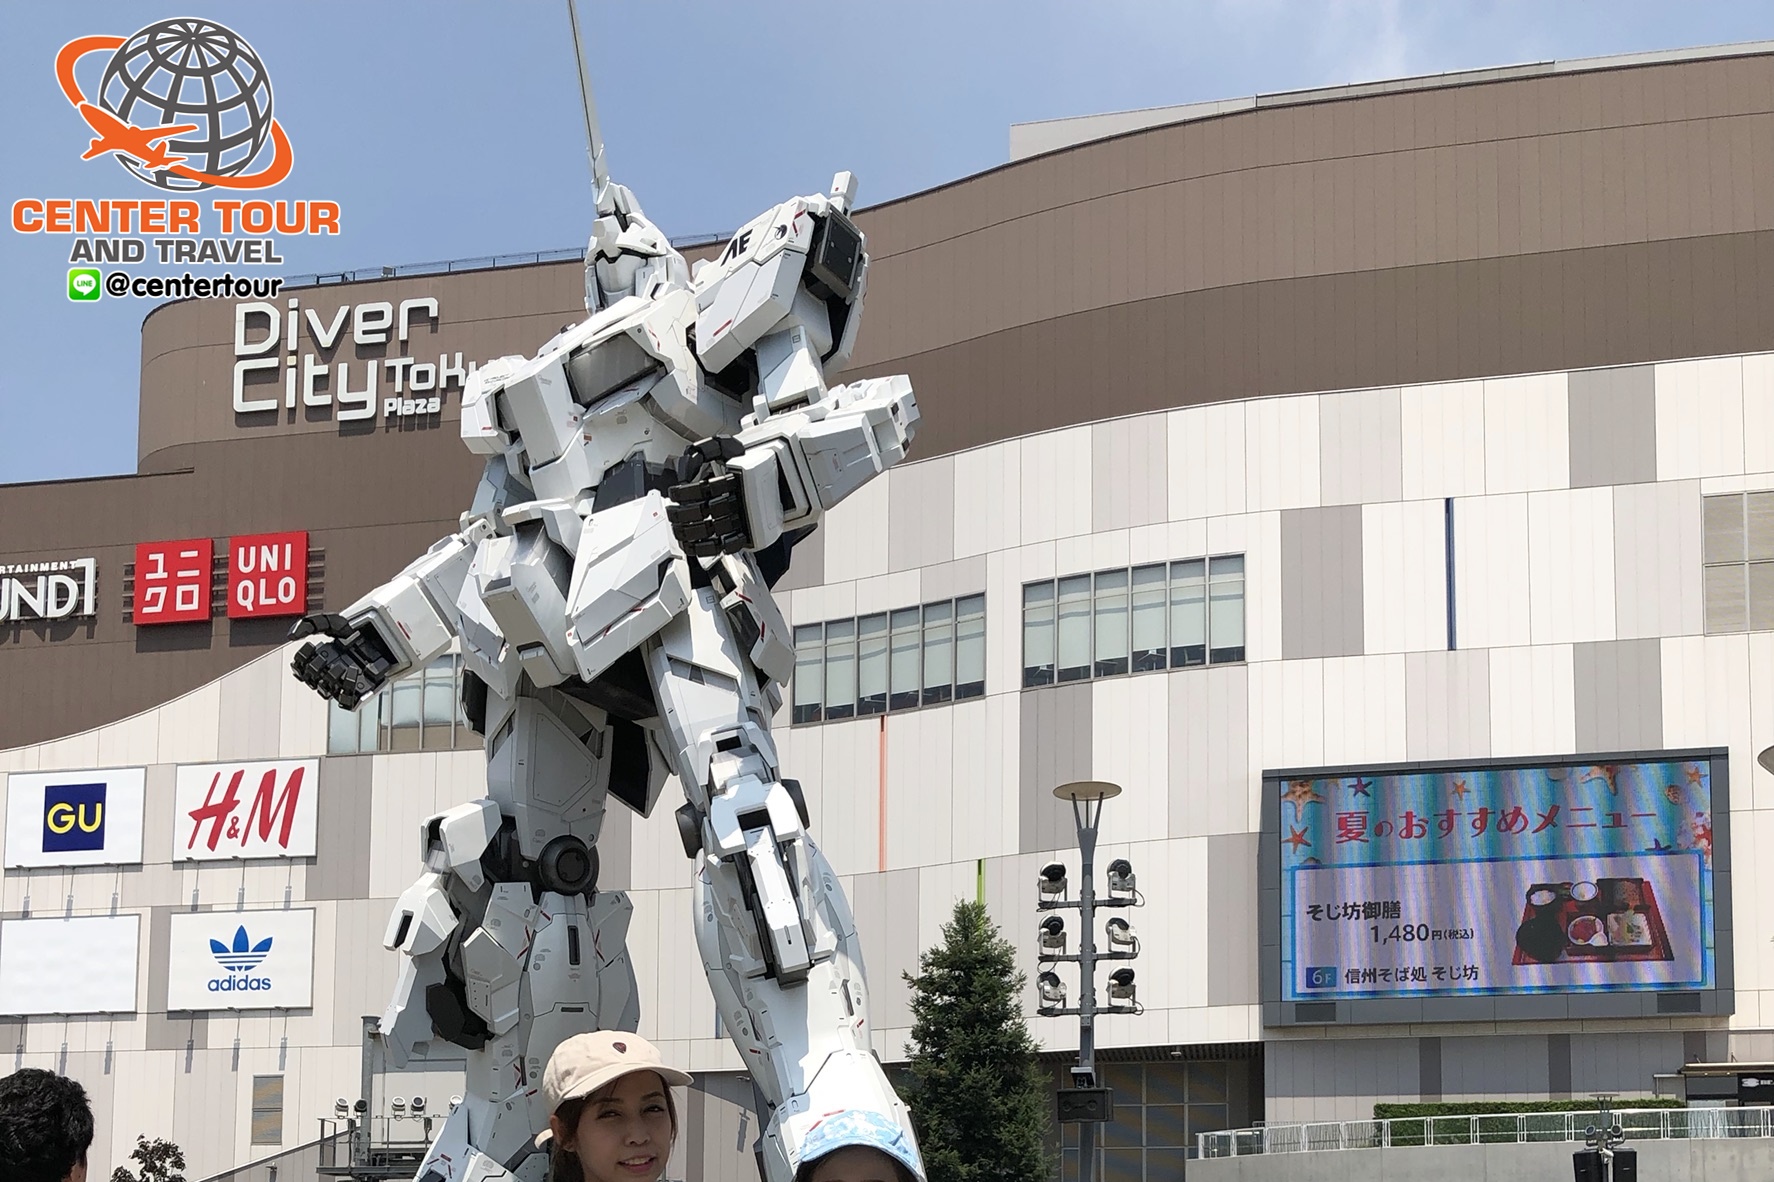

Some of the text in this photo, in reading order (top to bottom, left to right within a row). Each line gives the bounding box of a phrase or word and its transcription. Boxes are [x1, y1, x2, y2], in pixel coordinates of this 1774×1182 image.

[234, 297, 439, 356] Diver
[233, 353, 378, 421] City
[384, 396, 441, 417] Plaza
[238, 543, 292, 574] UNI
[236, 576, 296, 612] QLO
[47, 803, 102, 834] GU
[188, 766, 305, 852] H&M
[1335, 804, 1657, 844] 夏のおすすめメニュー
[1306, 901, 1402, 921] そじ坊御膳
[207, 974, 272, 992] adidas
[1344, 967, 1427, 984] 信州そば処
[1432, 964, 1478, 981] そじ坊
